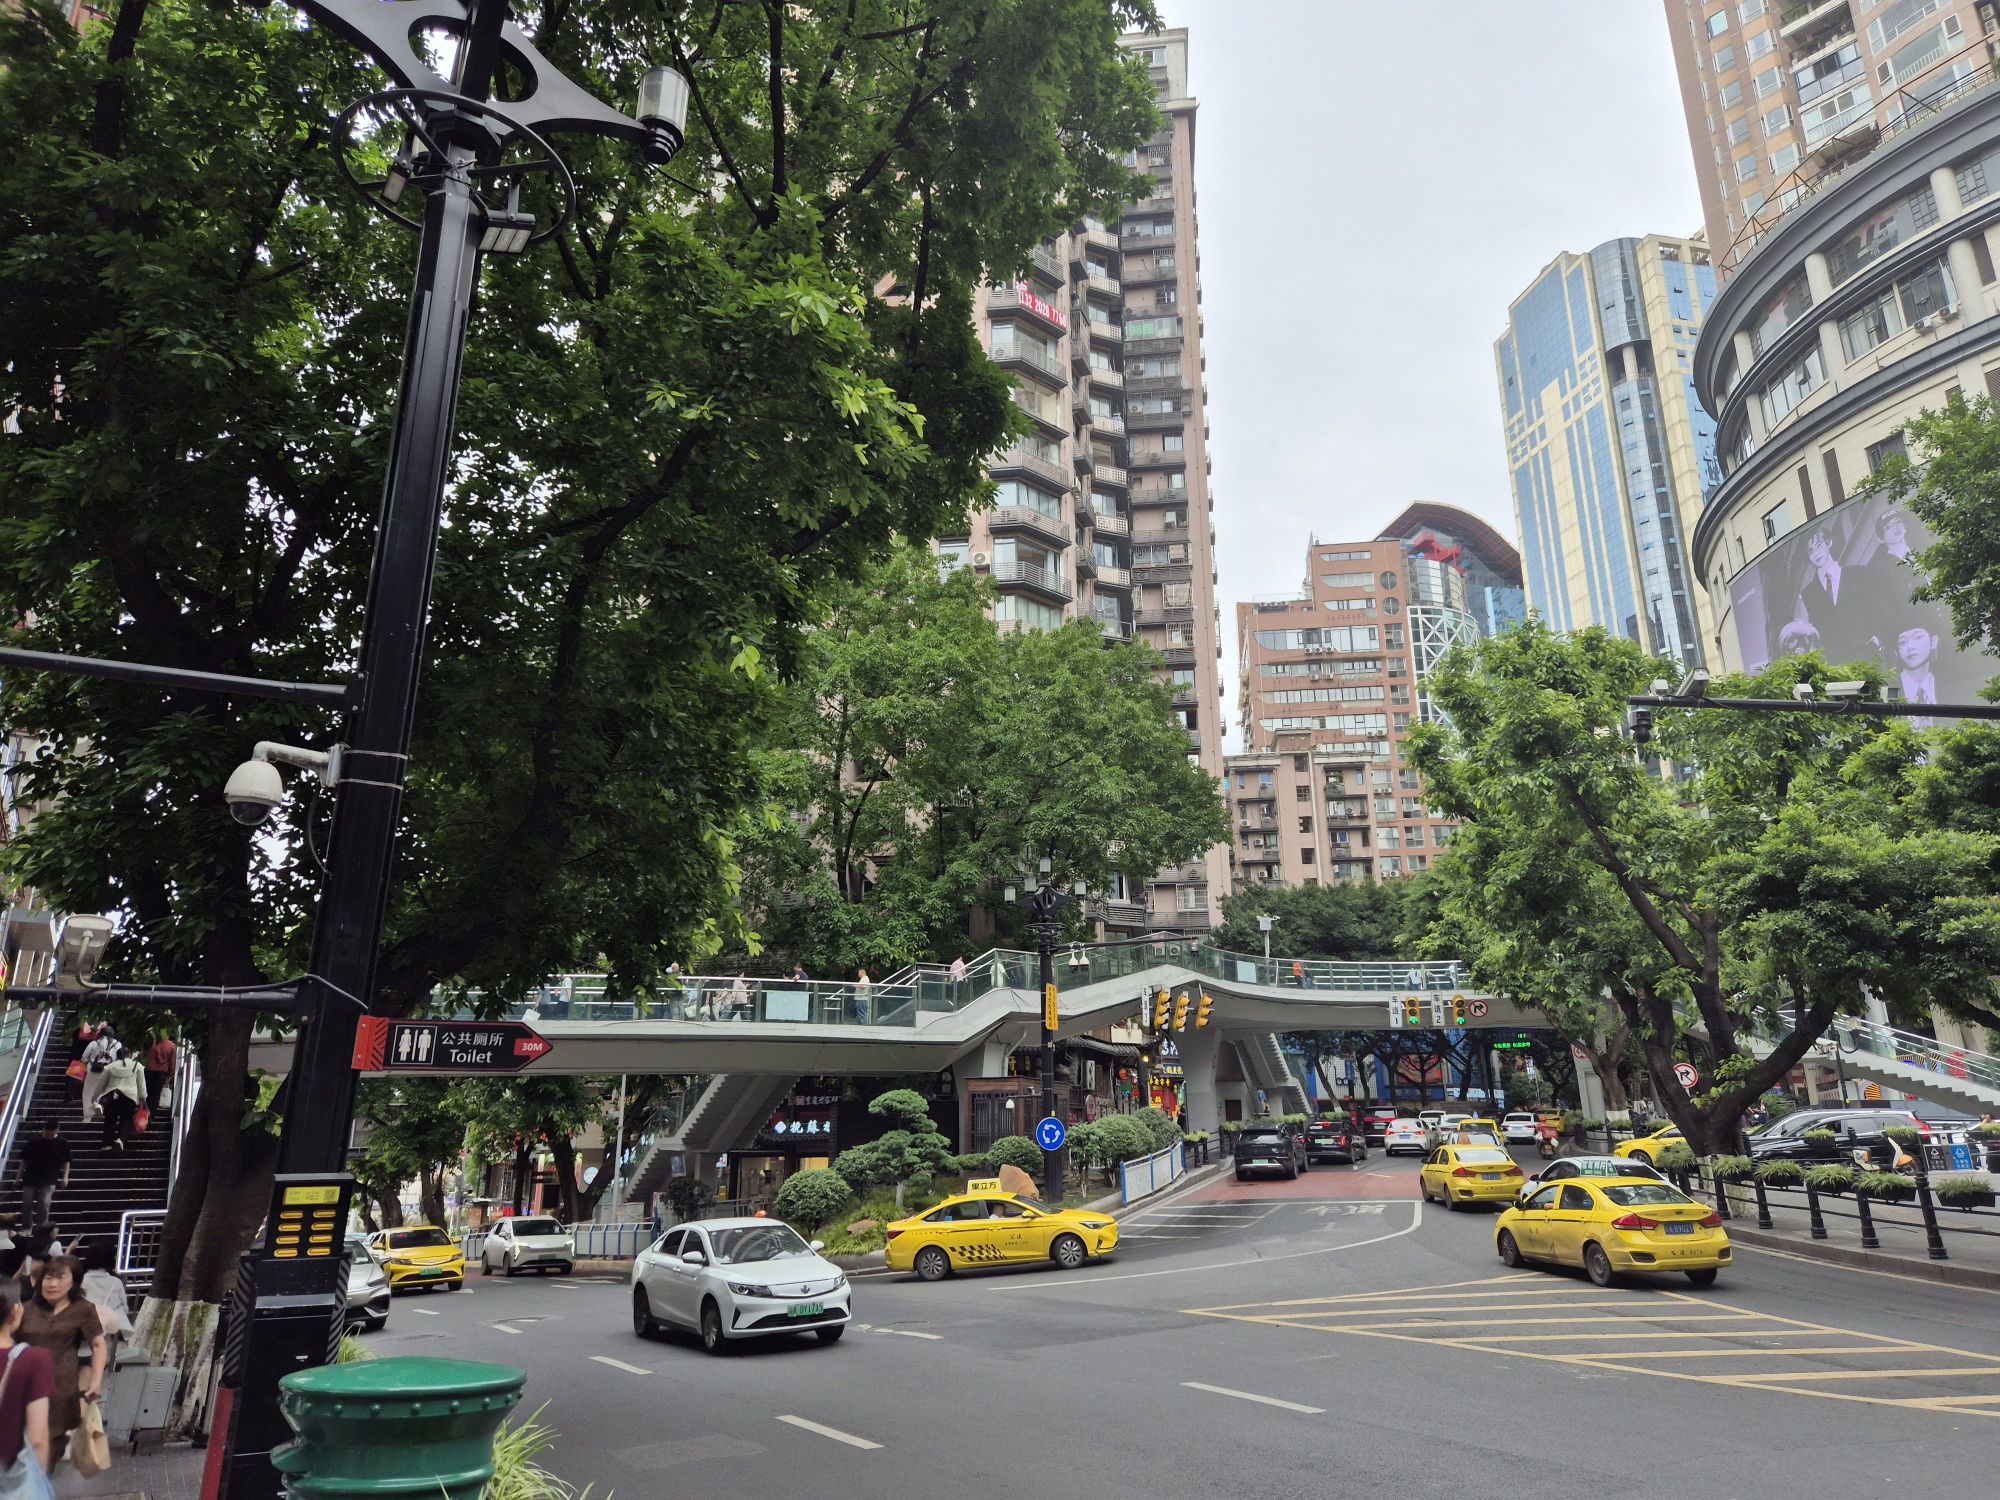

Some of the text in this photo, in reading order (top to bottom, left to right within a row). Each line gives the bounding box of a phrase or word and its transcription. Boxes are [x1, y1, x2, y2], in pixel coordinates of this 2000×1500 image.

[441, 1031, 505, 1047] 公共厕所
[521, 1042, 544, 1052] 30M
[450, 1049, 493, 1064] Toilet
[971, 1181, 998, 1191] 果立方
